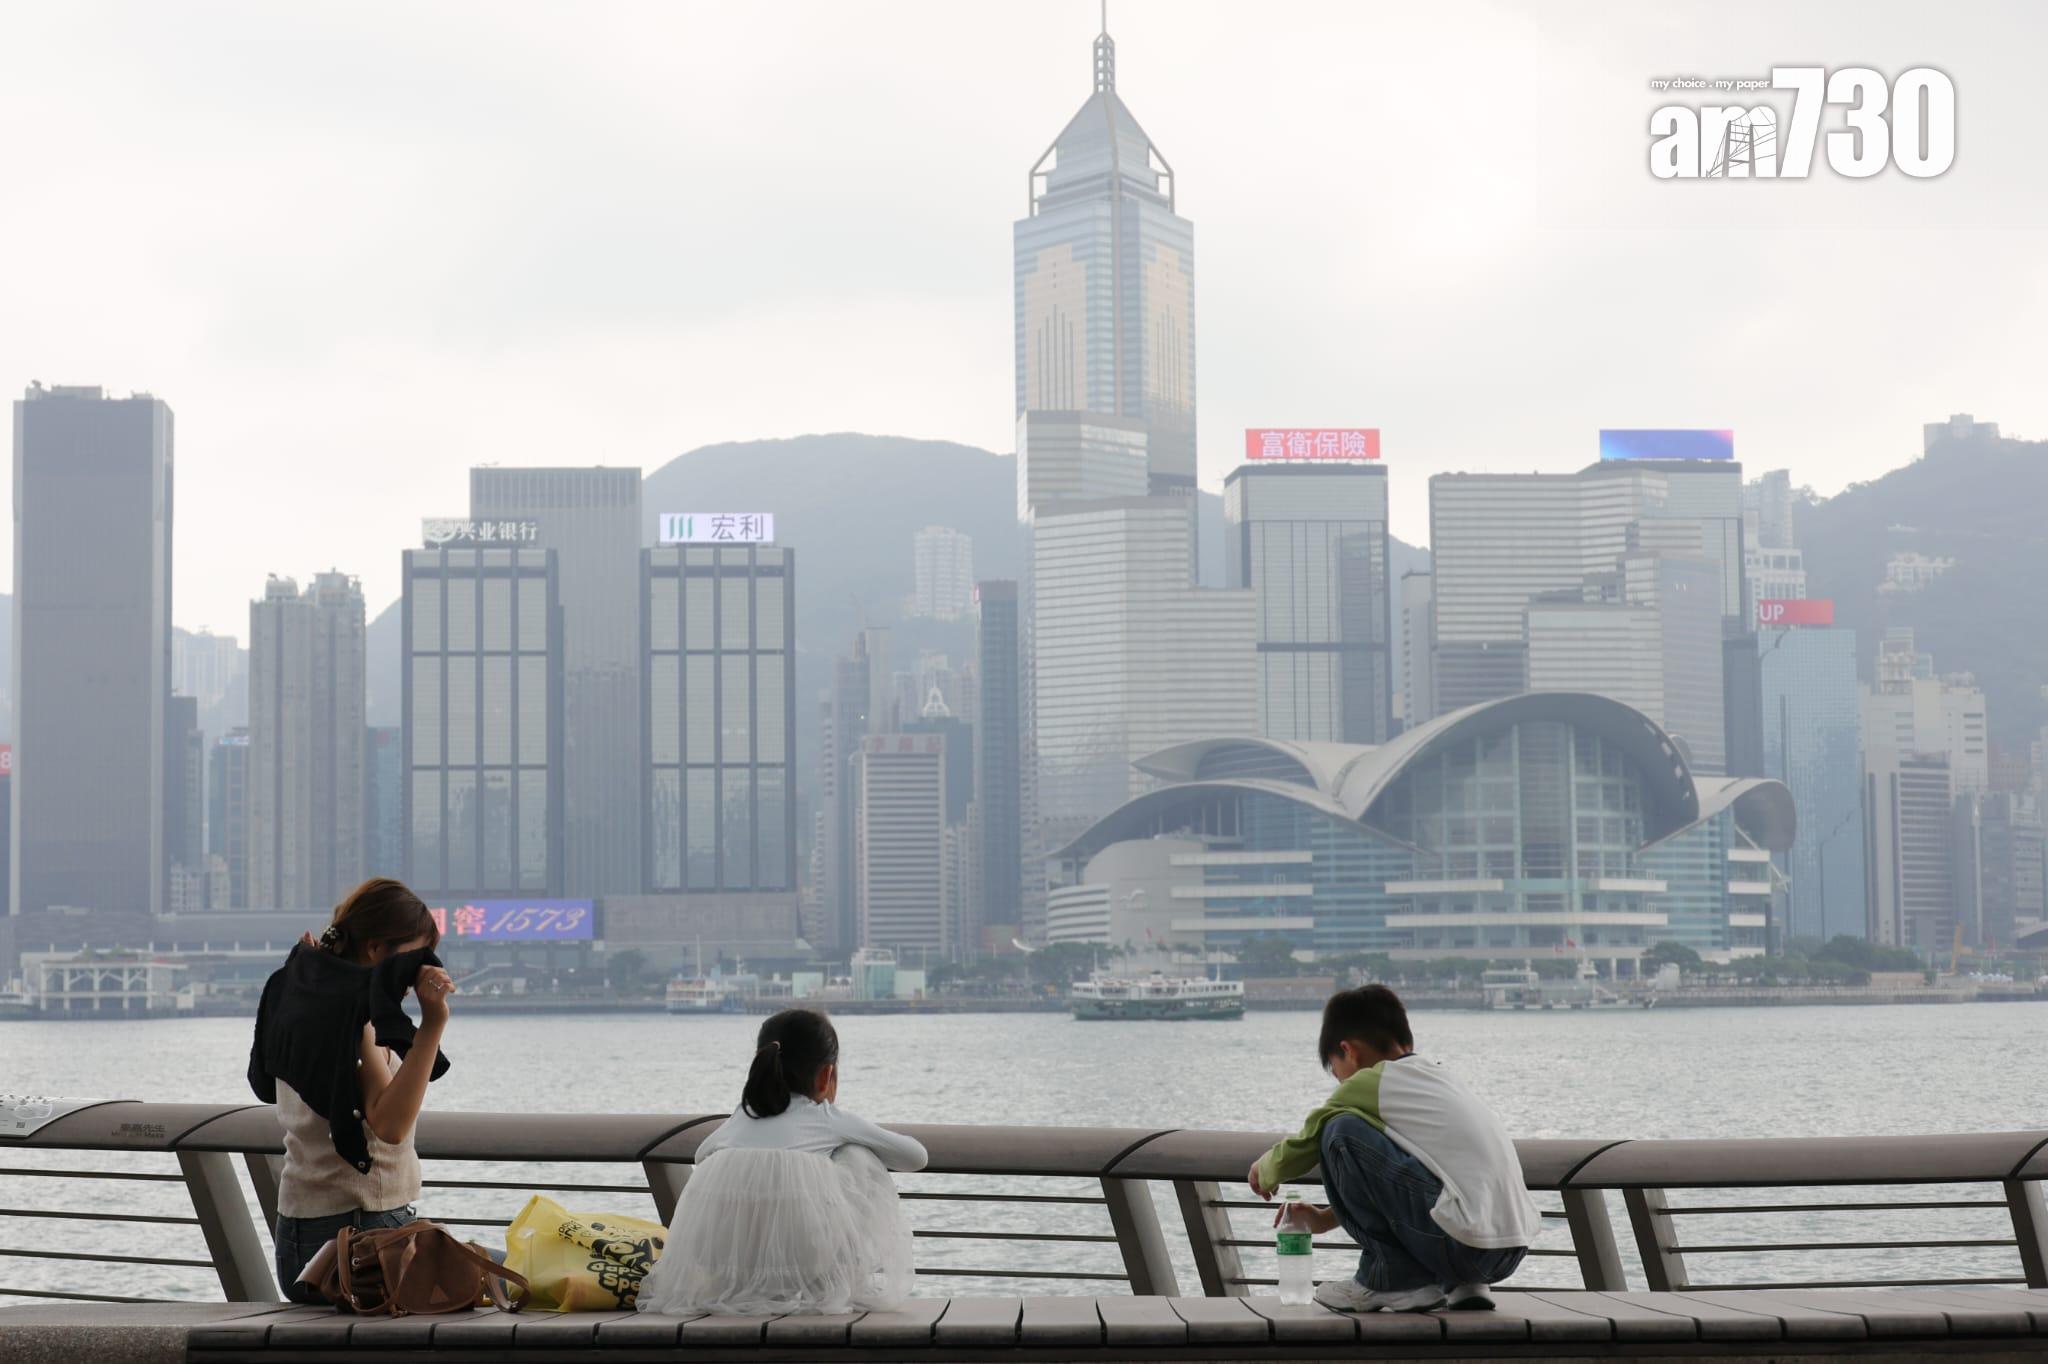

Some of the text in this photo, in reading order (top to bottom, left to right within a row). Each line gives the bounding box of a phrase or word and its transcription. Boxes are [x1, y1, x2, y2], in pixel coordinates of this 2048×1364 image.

[1260, 431, 1366, 457] 富衛保險
[457, 520, 538, 541] 兴业银行
[711, 514, 764, 541] 宏利
